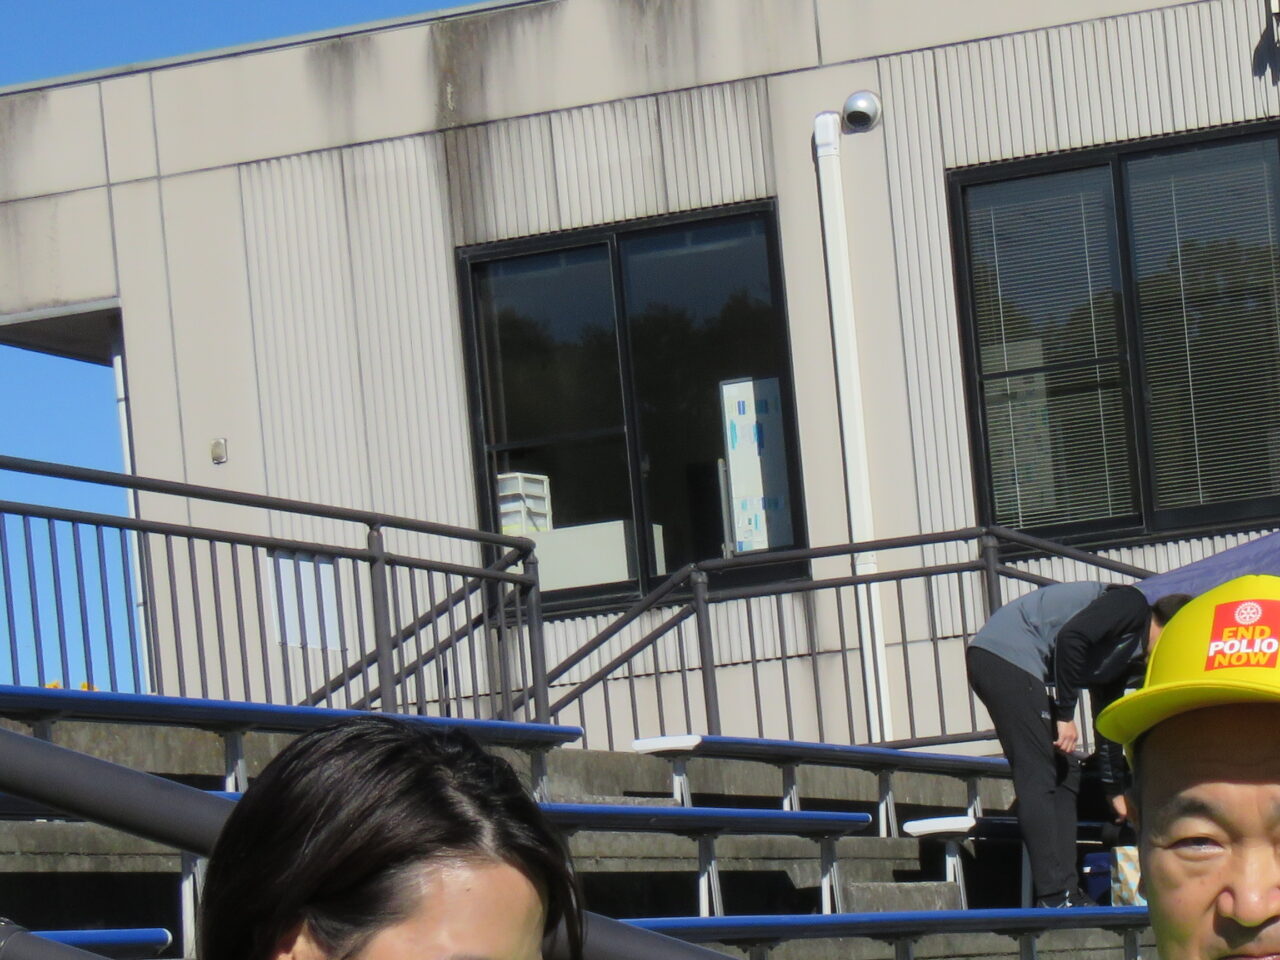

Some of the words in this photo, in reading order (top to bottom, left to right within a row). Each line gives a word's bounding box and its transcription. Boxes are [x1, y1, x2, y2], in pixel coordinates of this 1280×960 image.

[1222, 625, 1272, 641] END
[1208, 638, 1279, 656] POLIO
[1213, 652, 1271, 667] NOW
